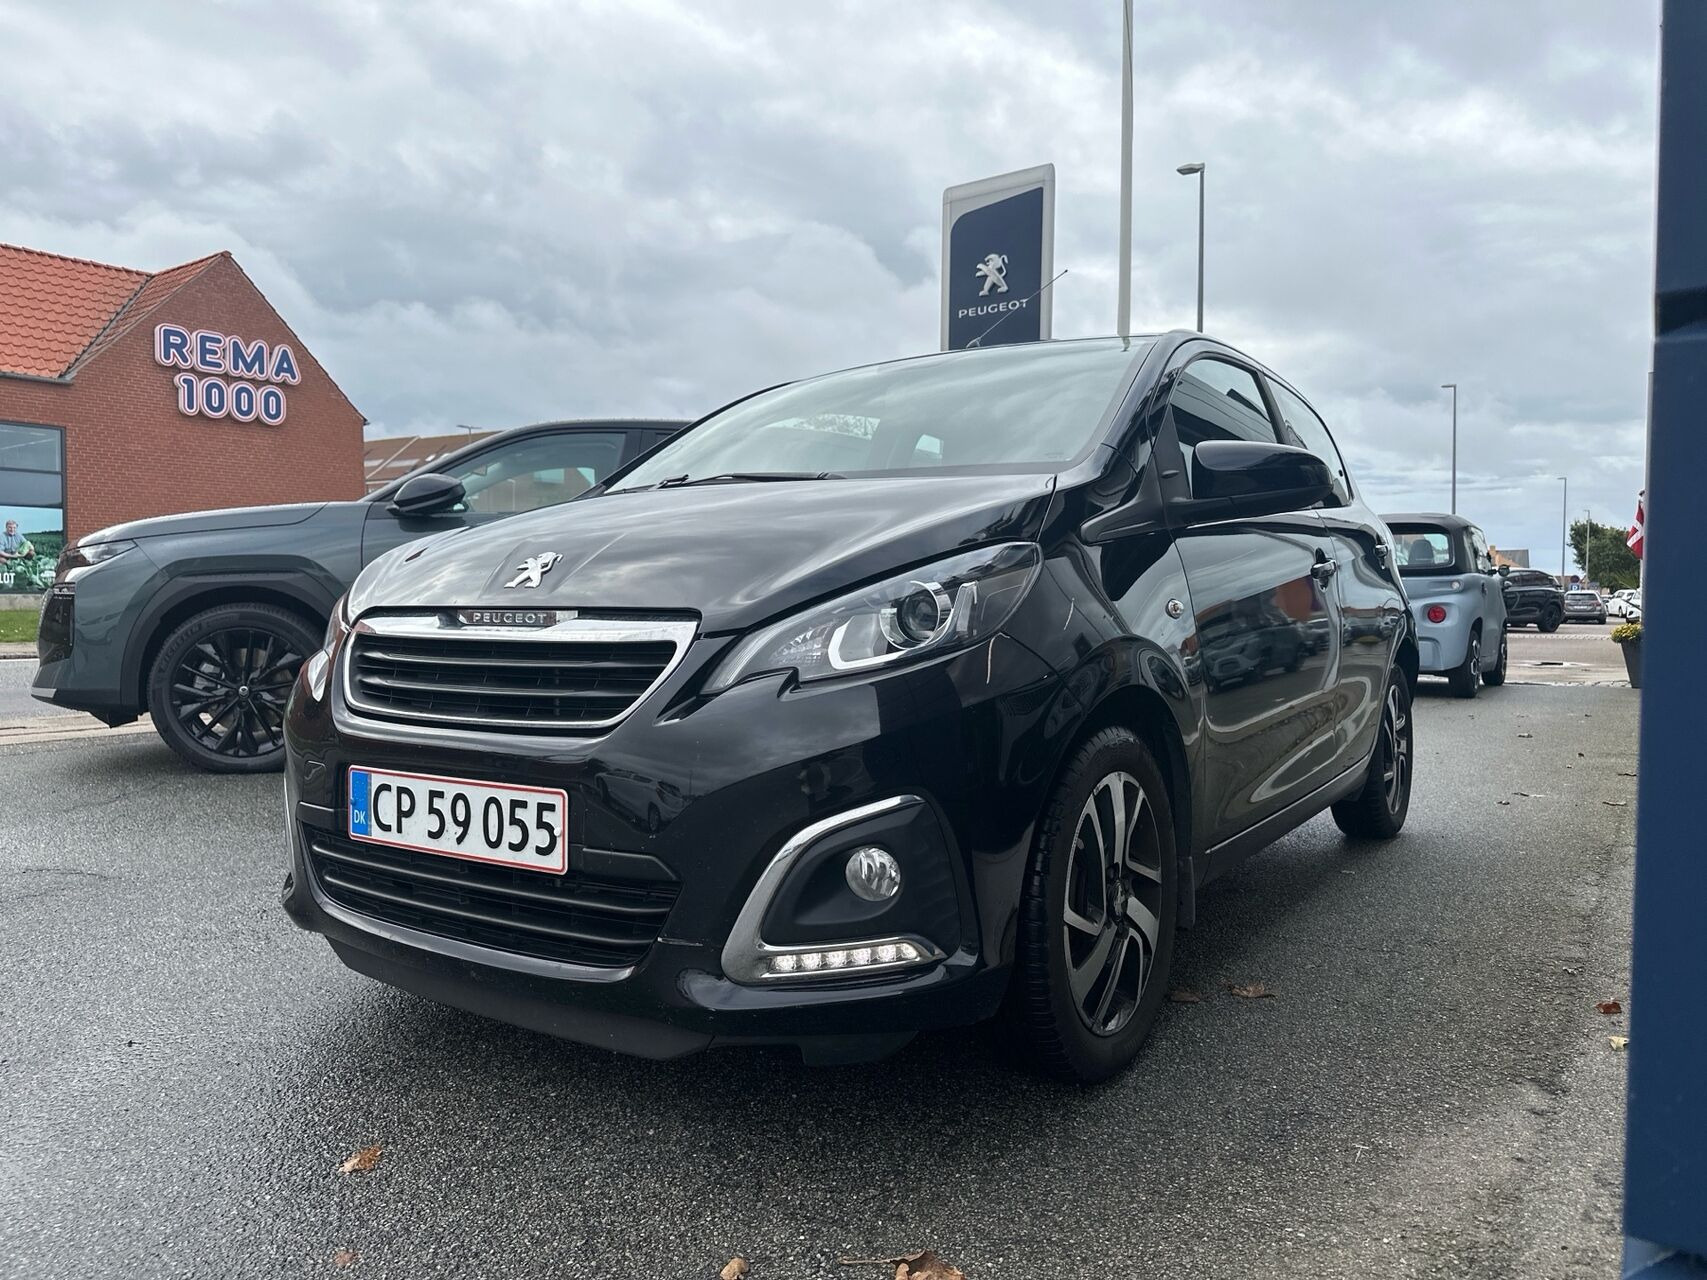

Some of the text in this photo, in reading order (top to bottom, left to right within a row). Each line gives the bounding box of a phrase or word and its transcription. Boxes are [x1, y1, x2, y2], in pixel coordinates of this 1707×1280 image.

[958, 299, 1029, 318] PEUGEOT
[154, 323, 301, 385] REMA
[174, 373, 286, 426] 1000
[472, 612, 547, 623] PEUGEOT
[353, 809, 366, 825] DK
[373, 783, 557, 856] CP 59 055
